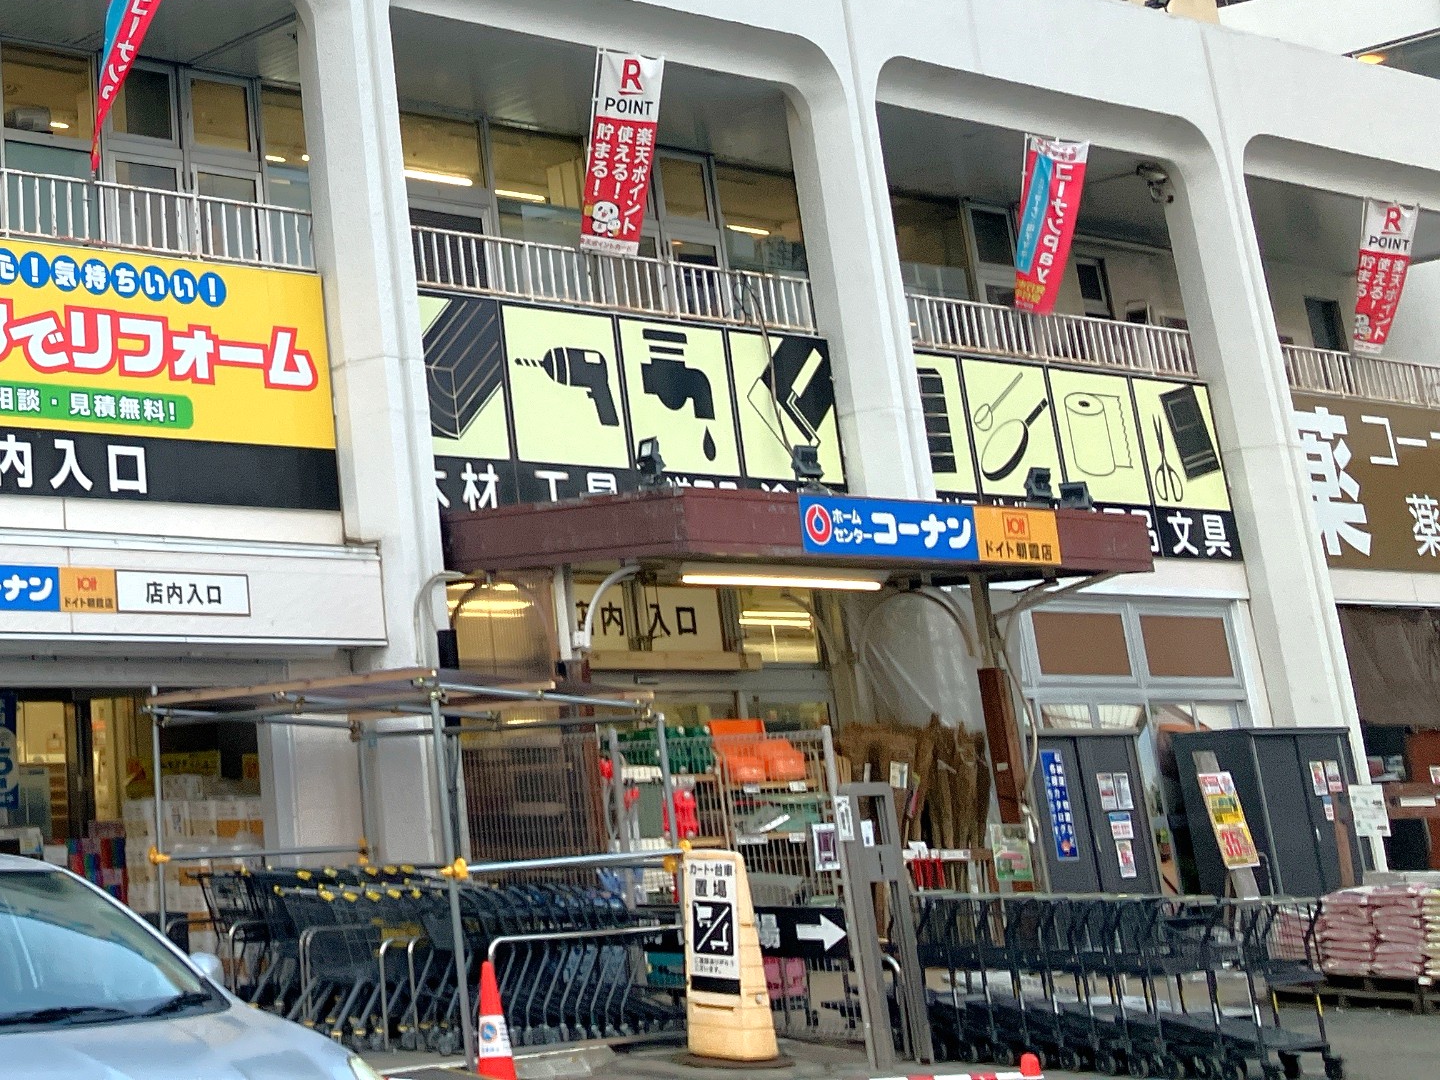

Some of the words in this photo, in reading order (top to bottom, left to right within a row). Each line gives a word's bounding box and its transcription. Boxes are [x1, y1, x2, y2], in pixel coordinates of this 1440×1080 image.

[621, 59, 643, 90] R
[605, 97, 654, 116] POINT
[623, 127, 653, 234] 楽天ポイント
[1369, 235, 1410, 251] POINT
[1361, 415, 1440, 466] コー
[832, 510, 861, 525] ホーム
[871, 511, 971, 550] コーナン
[833, 527, 873, 546] センター
[1168, 511, 1232, 558] 文具
[146, 581, 222, 605] 店内入口
